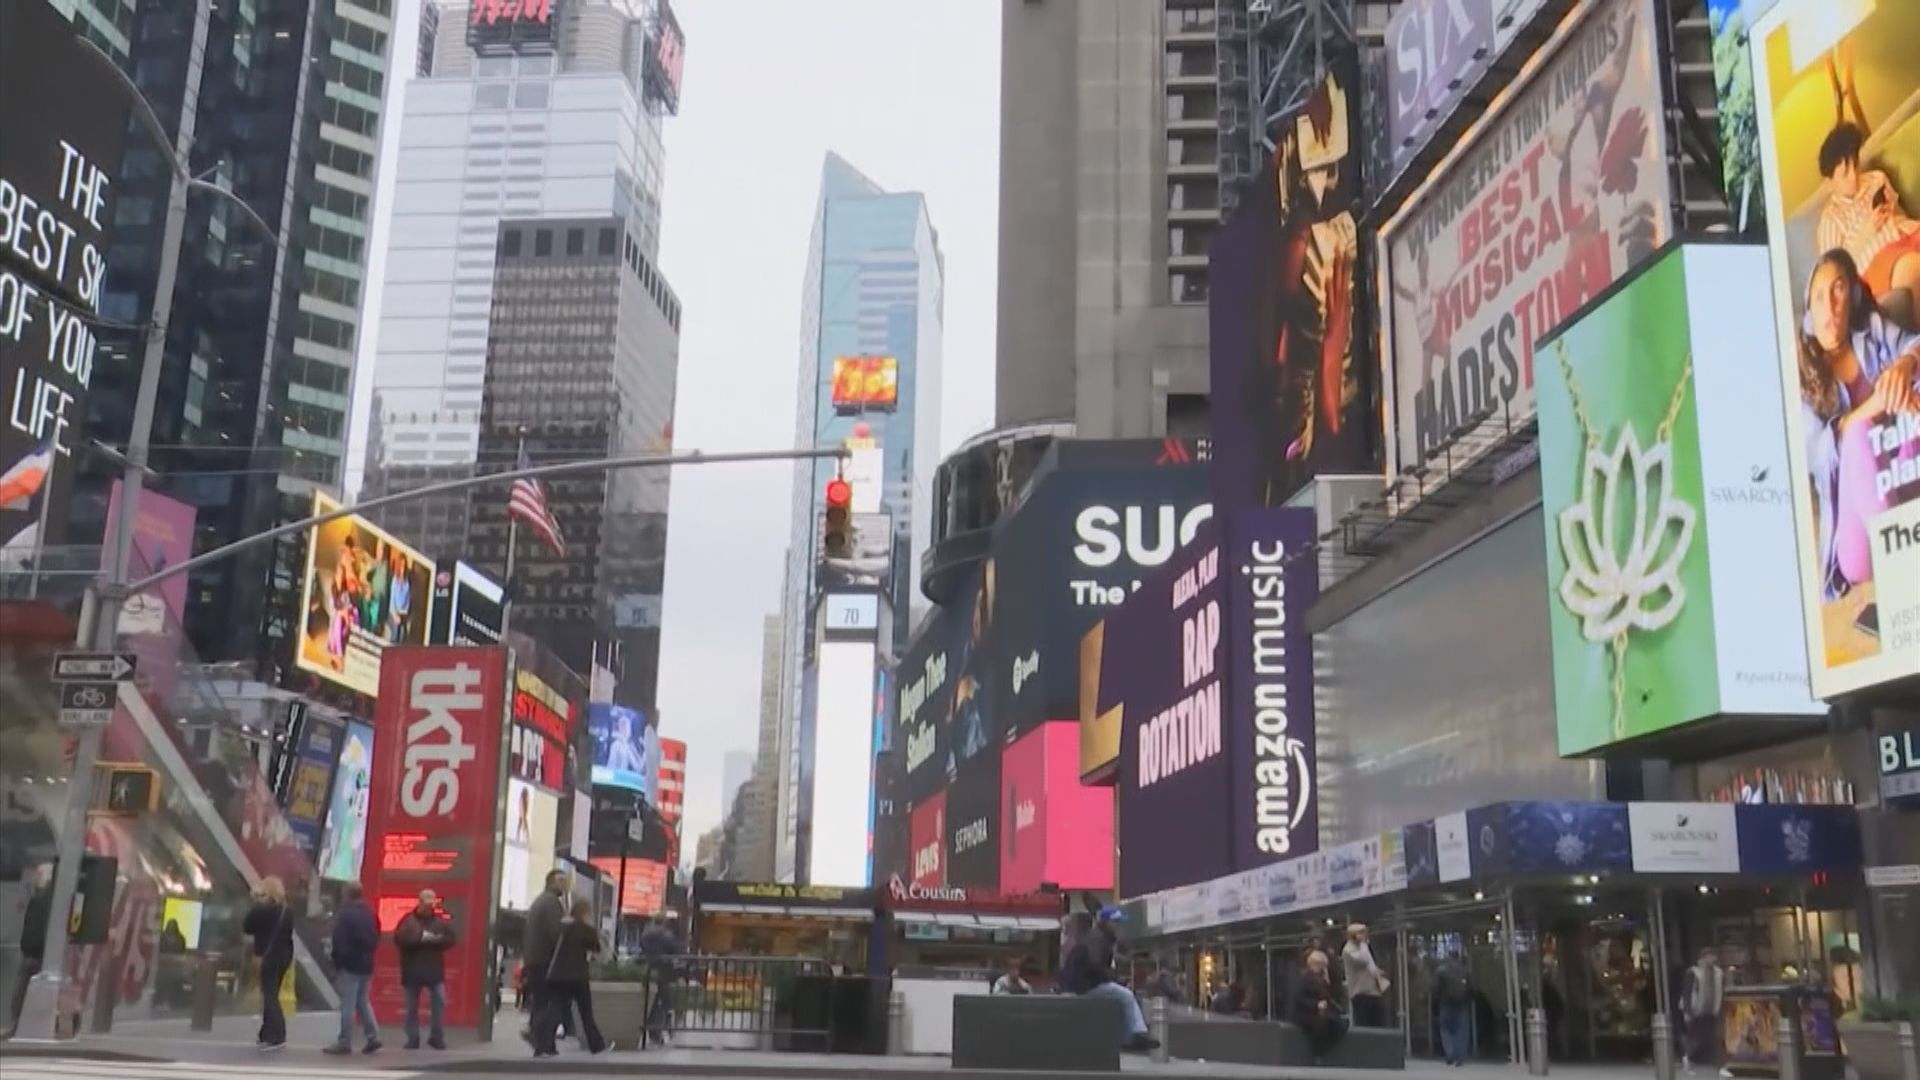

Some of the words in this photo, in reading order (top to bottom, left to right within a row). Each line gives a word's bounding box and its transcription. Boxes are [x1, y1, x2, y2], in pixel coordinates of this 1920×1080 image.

[1514, 83, 1551, 150] TONY
[1554, 10, 1618, 111] AWARDS
[0, 178, 77, 281] BEST
[58, 139, 110, 231] THE
[1461, 140, 1546, 266] BEST
[0, 272, 39, 342] OF
[1435, 181, 1585, 342] MUSICAL
[10, 366, 75, 458] LIFE
[436, 586, 450, 598] LG
[843, 607, 860, 626] 70
[1069, 579, 1126, 606] The
[1241, 539, 1286, 675] music
[1183, 600, 1221, 689] RAP
[401, 661, 483, 818] tkts
[1138, 679, 1222, 789] ROTATION
[1254, 684, 1291, 855] amazon
[954, 815, 988, 854] SEPHORA
